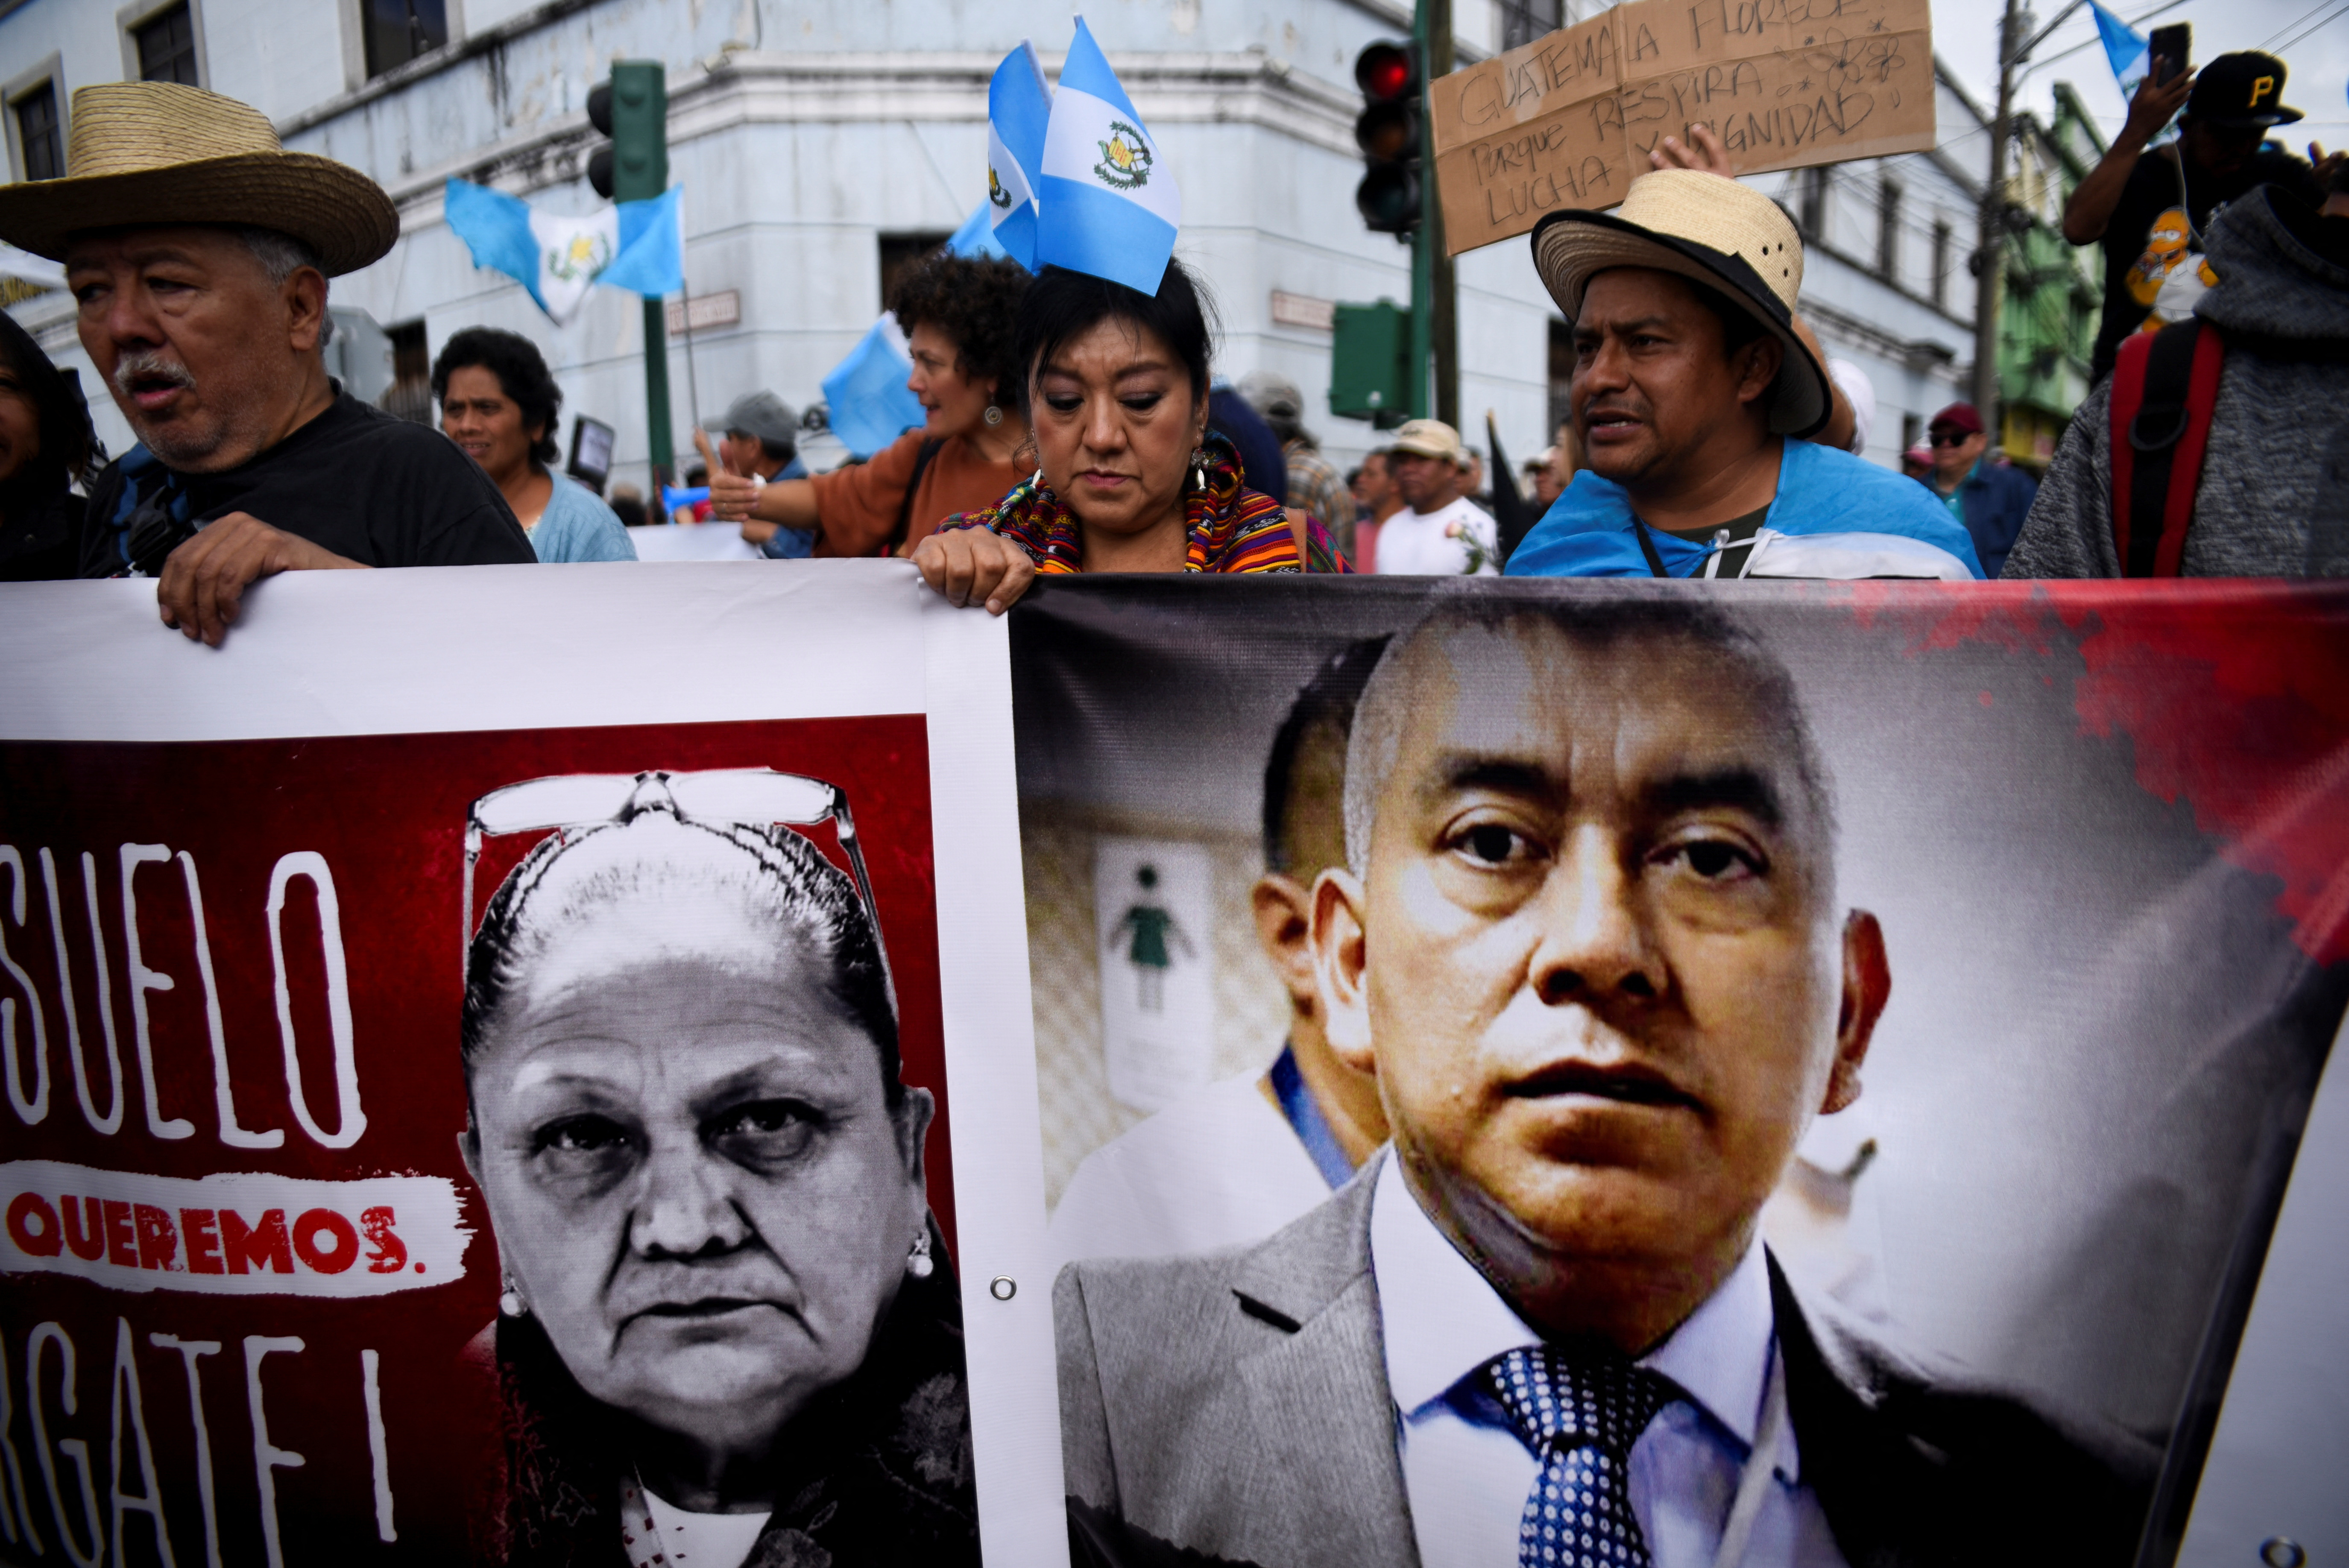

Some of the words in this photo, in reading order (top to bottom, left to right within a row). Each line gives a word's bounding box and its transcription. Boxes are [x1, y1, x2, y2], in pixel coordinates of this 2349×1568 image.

[1459, 22, 1661, 126] GUATEMALA
[1590, 61, 1765, 141] RESPIRA
[2247, 75, 2274, 108] P
[1487, 155, 1612, 225] LUCHA
[6, 1191, 426, 1275] QUEREMOS.
